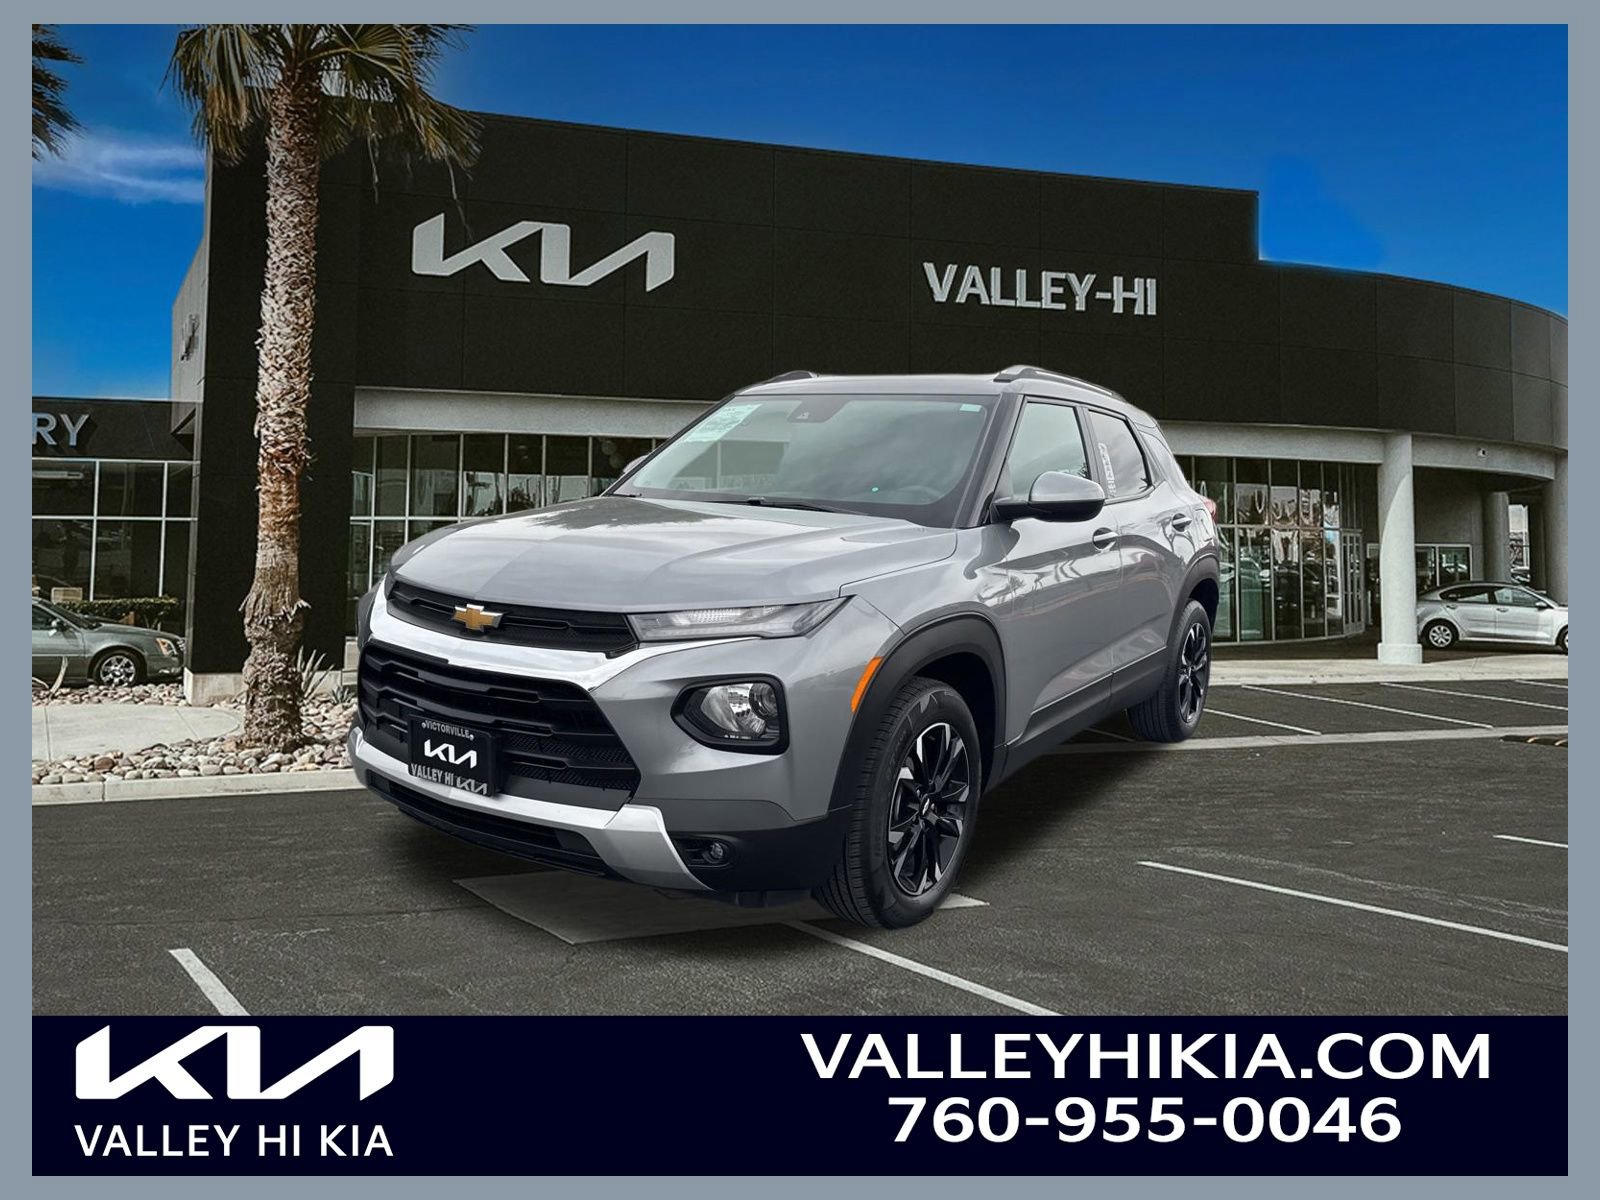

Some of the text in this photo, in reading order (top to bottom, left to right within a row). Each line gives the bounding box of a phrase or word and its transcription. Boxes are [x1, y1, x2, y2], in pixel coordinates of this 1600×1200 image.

[412, 213, 674, 291] KIA
[924, 263, 1156, 315] VALLEY-HI
[425, 720, 471, 739] VICTORVILLE
[424, 739, 477, 769] KIA
[411, 762, 443, 783] VALLEY
[444, 772, 454, 786] HI
